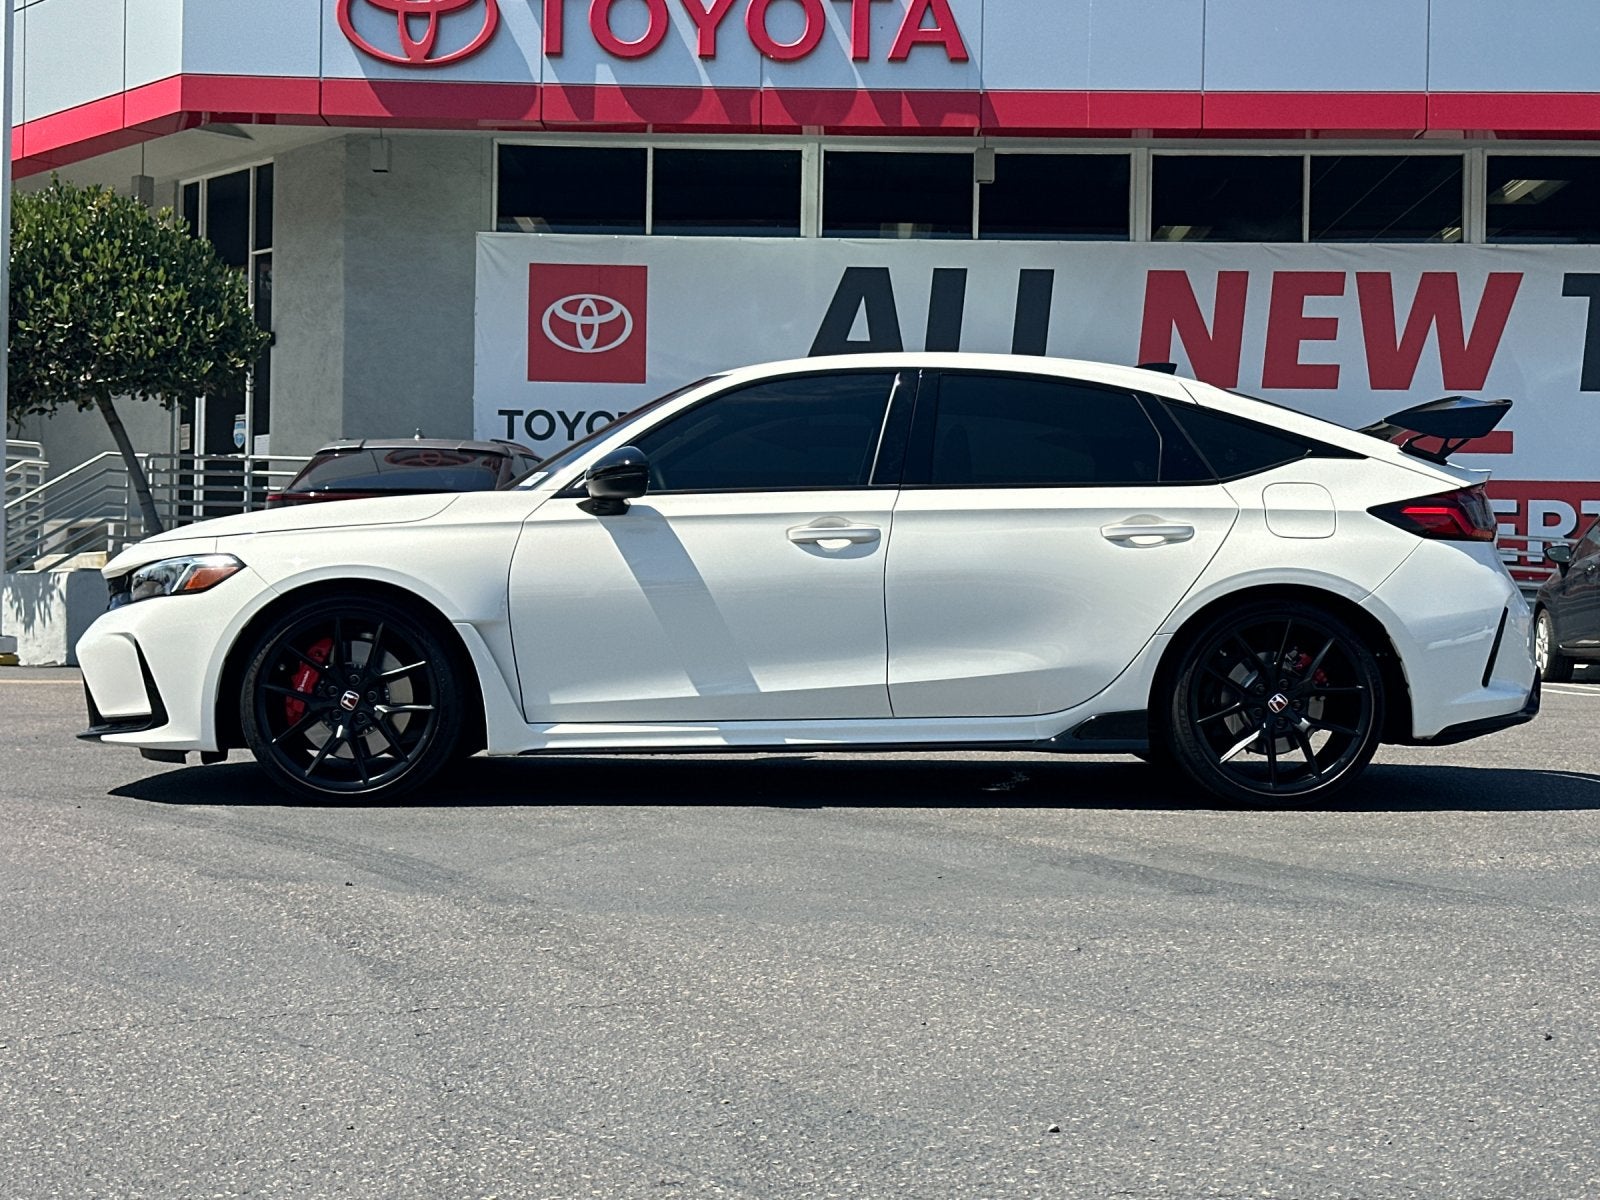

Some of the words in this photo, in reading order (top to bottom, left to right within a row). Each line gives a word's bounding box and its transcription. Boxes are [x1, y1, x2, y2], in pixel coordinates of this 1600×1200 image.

[543, 0, 969, 62] TOYOTA
[1137, 269, 1525, 391] NEW
[497, 408, 629, 442] TOYO
